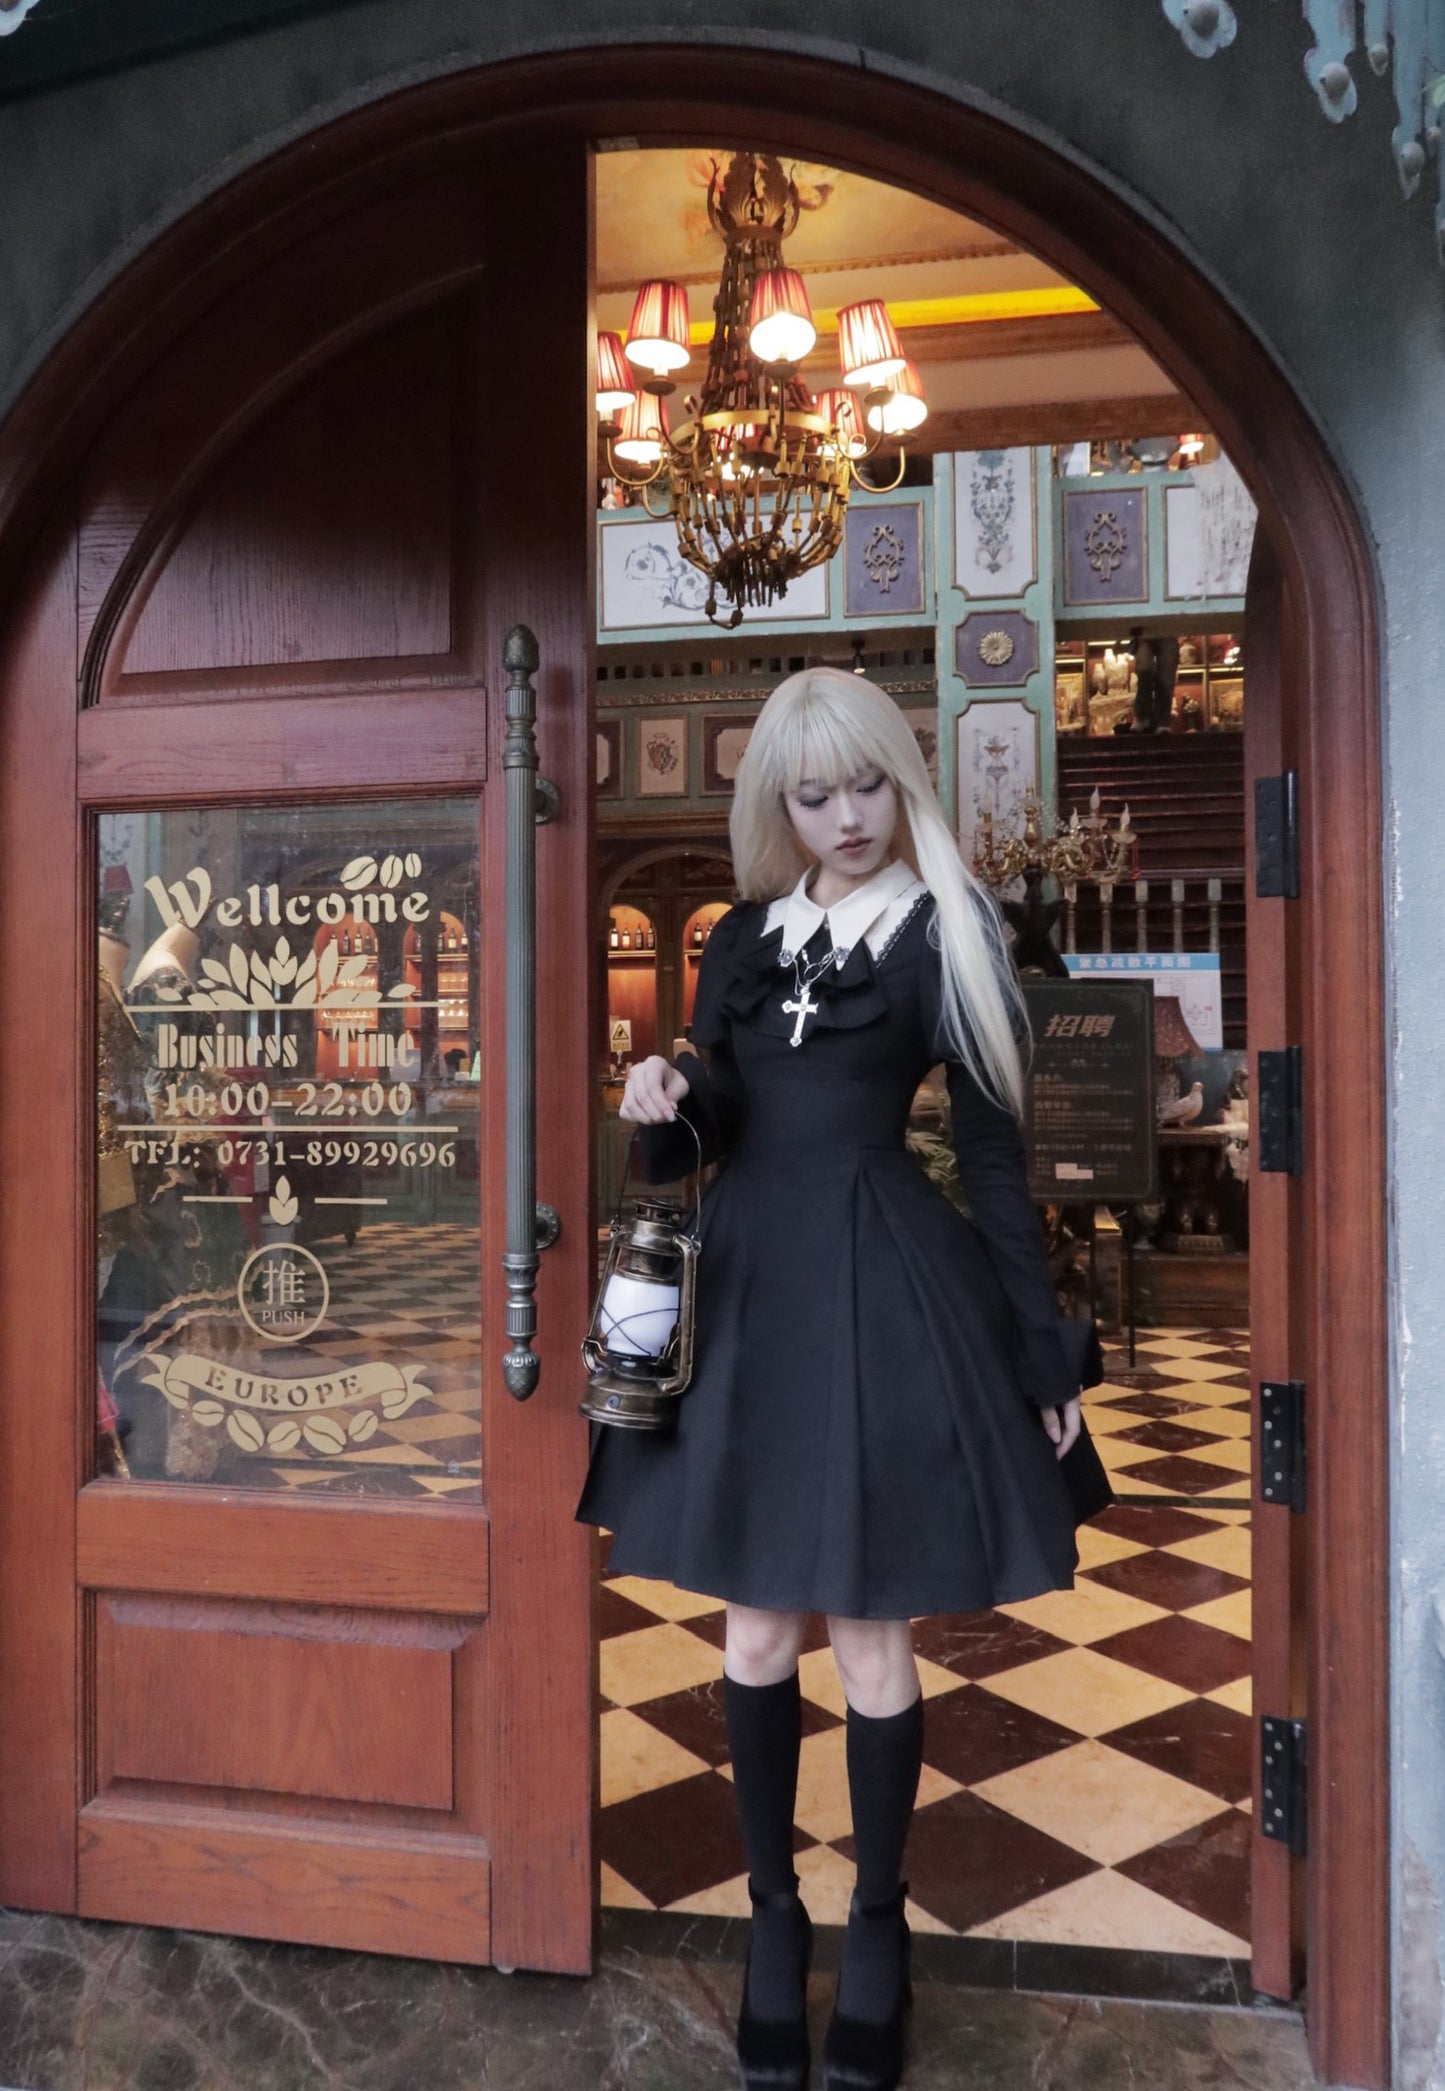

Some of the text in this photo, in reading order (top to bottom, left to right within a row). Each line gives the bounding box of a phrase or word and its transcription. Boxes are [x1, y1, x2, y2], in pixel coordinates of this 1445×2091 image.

[144, 866, 430, 929] Wellcome
[157, 1021, 415, 1069] Business Time
[1044, 1014, 1116, 1038] 招聘
[164, 1081, 412, 1117] 10:00-22:00
[217, 1140, 456, 1168] 0731-89929696
[262, 1259, 306, 1306] 推
[261, 1309, 306, 1326] PUSH
[204, 1365, 363, 1407] EUROPE
